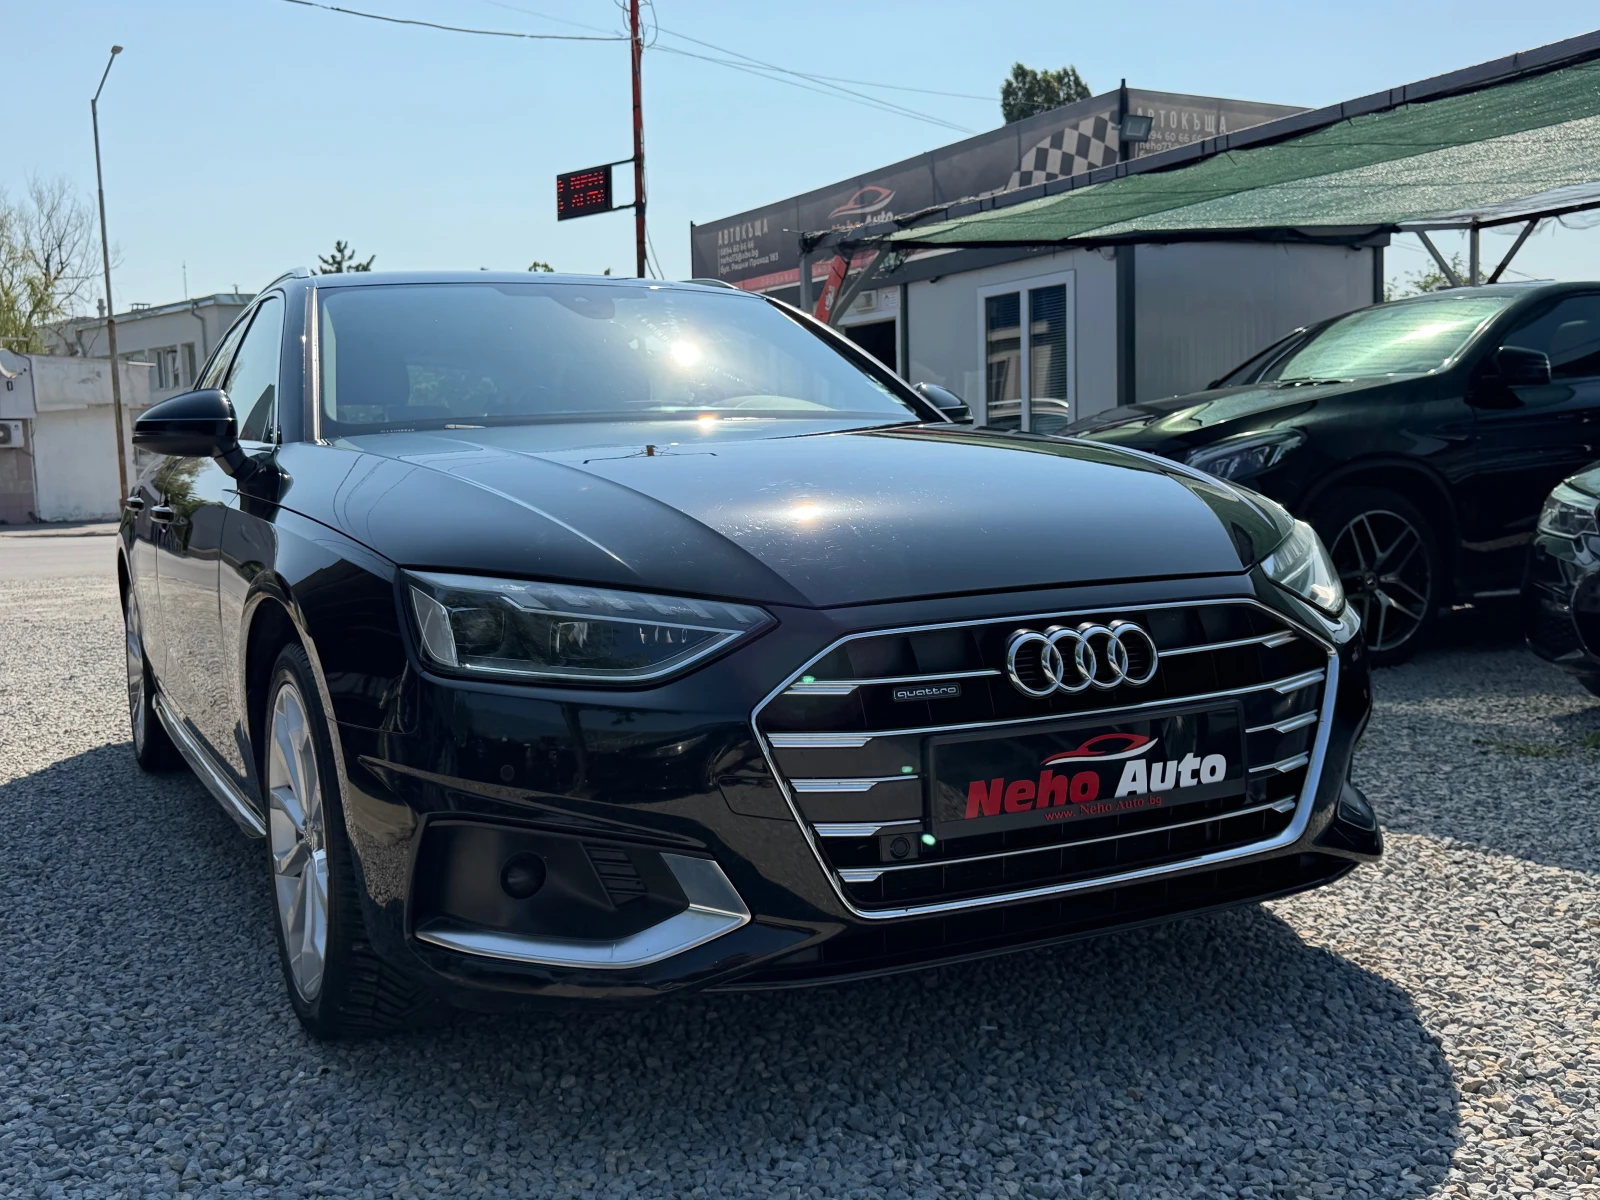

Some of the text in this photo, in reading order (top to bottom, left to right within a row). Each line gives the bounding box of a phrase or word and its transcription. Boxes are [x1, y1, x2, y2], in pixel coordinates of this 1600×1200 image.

[1165, 132, 1176, 141] 60
[1178, 133, 1190, 143] 66
[718, 217, 768, 246] АВТОКЪЩА
[897, 687, 956, 699] quattro
[965, 752, 1227, 819] Neho Auto
[1044, 810, 1076, 821] www.
[1079, 802, 1113, 816] Neho
[1115, 798, 1145, 811] Auto
